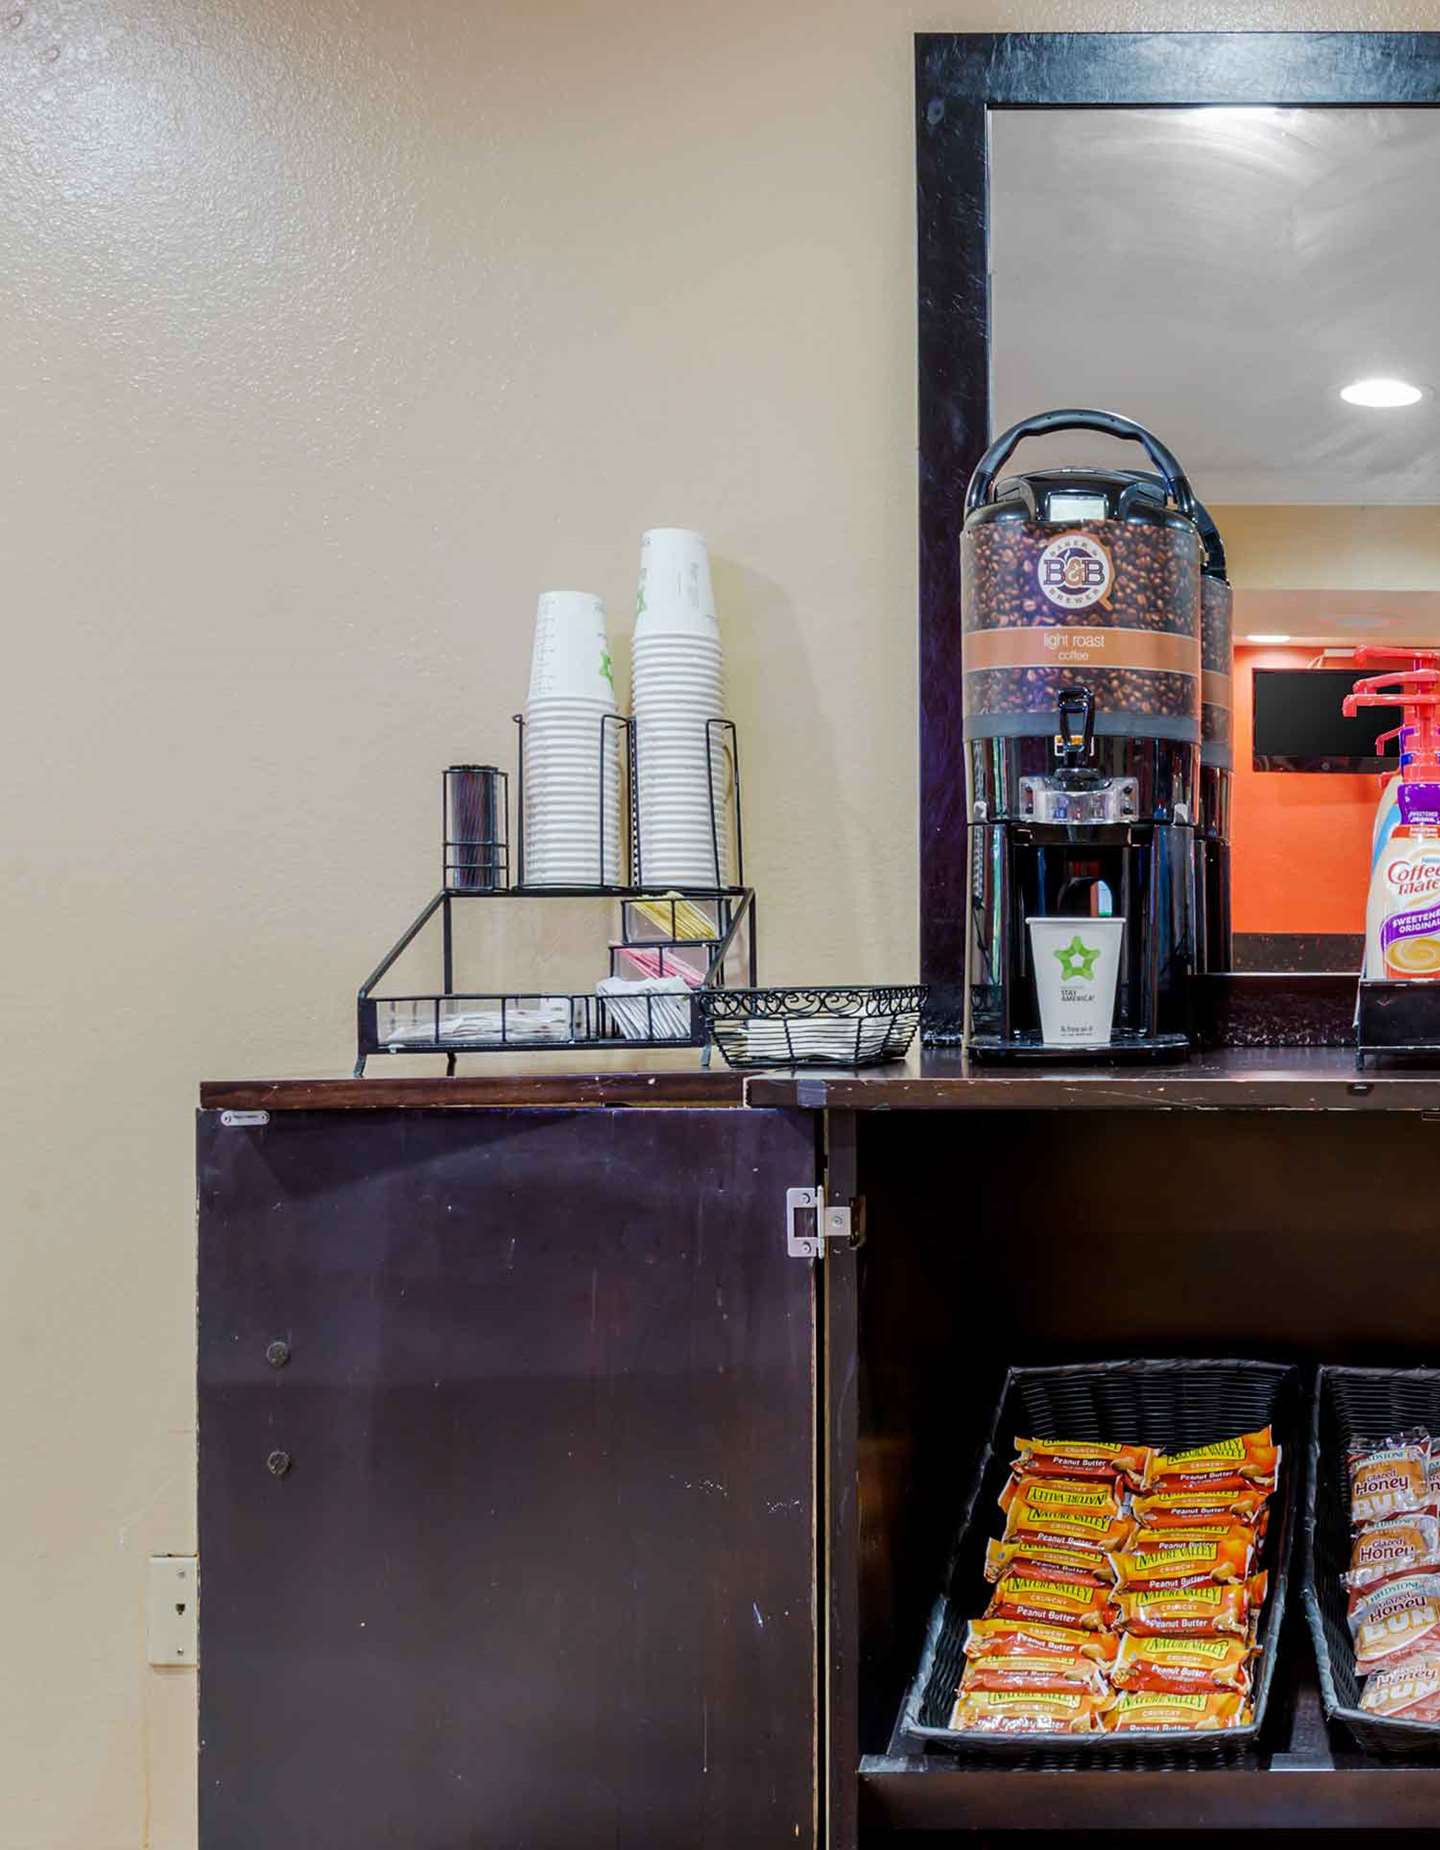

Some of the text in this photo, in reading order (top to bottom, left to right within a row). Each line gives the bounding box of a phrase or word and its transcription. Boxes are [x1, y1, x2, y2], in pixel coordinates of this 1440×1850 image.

[1043, 559, 1105, 586] B&B
[1043, 632, 1105, 650] light roast
[1057, 650, 1089, 660] coffee
[1398, 879, 1440, 896] mate
[1053, 1456, 1106, 1468] Peanut Butter
[1180, 1470, 1233, 1481] Peanut Butter
[1355, 1476, 1409, 1495] Honey
[1170, 1506, 1225, 1515] Peanut Butter
[1037, 1532, 1066, 1543] Peanut
[1158, 1542, 1187, 1550] Peanut
[1372, 1539, 1403, 1549] Glazed
[1139, 1551, 1178, 1568] NATURE
[1011, 1577, 1055, 1591] NATURE
[1149, 1579, 1179, 1589] Peanut
[1016, 1605, 1047, 1618] Peanut
[1048, 1610, 1076, 1623] Butter
[1369, 1596, 1427, 1623] Honey
[1150, 1618, 1208, 1628] Peanut Butter
[1362, 1605, 1437, 1643] BUN
[1047, 1639, 1076, 1652] Butter
[1151, 1664, 1180, 1676] Peanut
